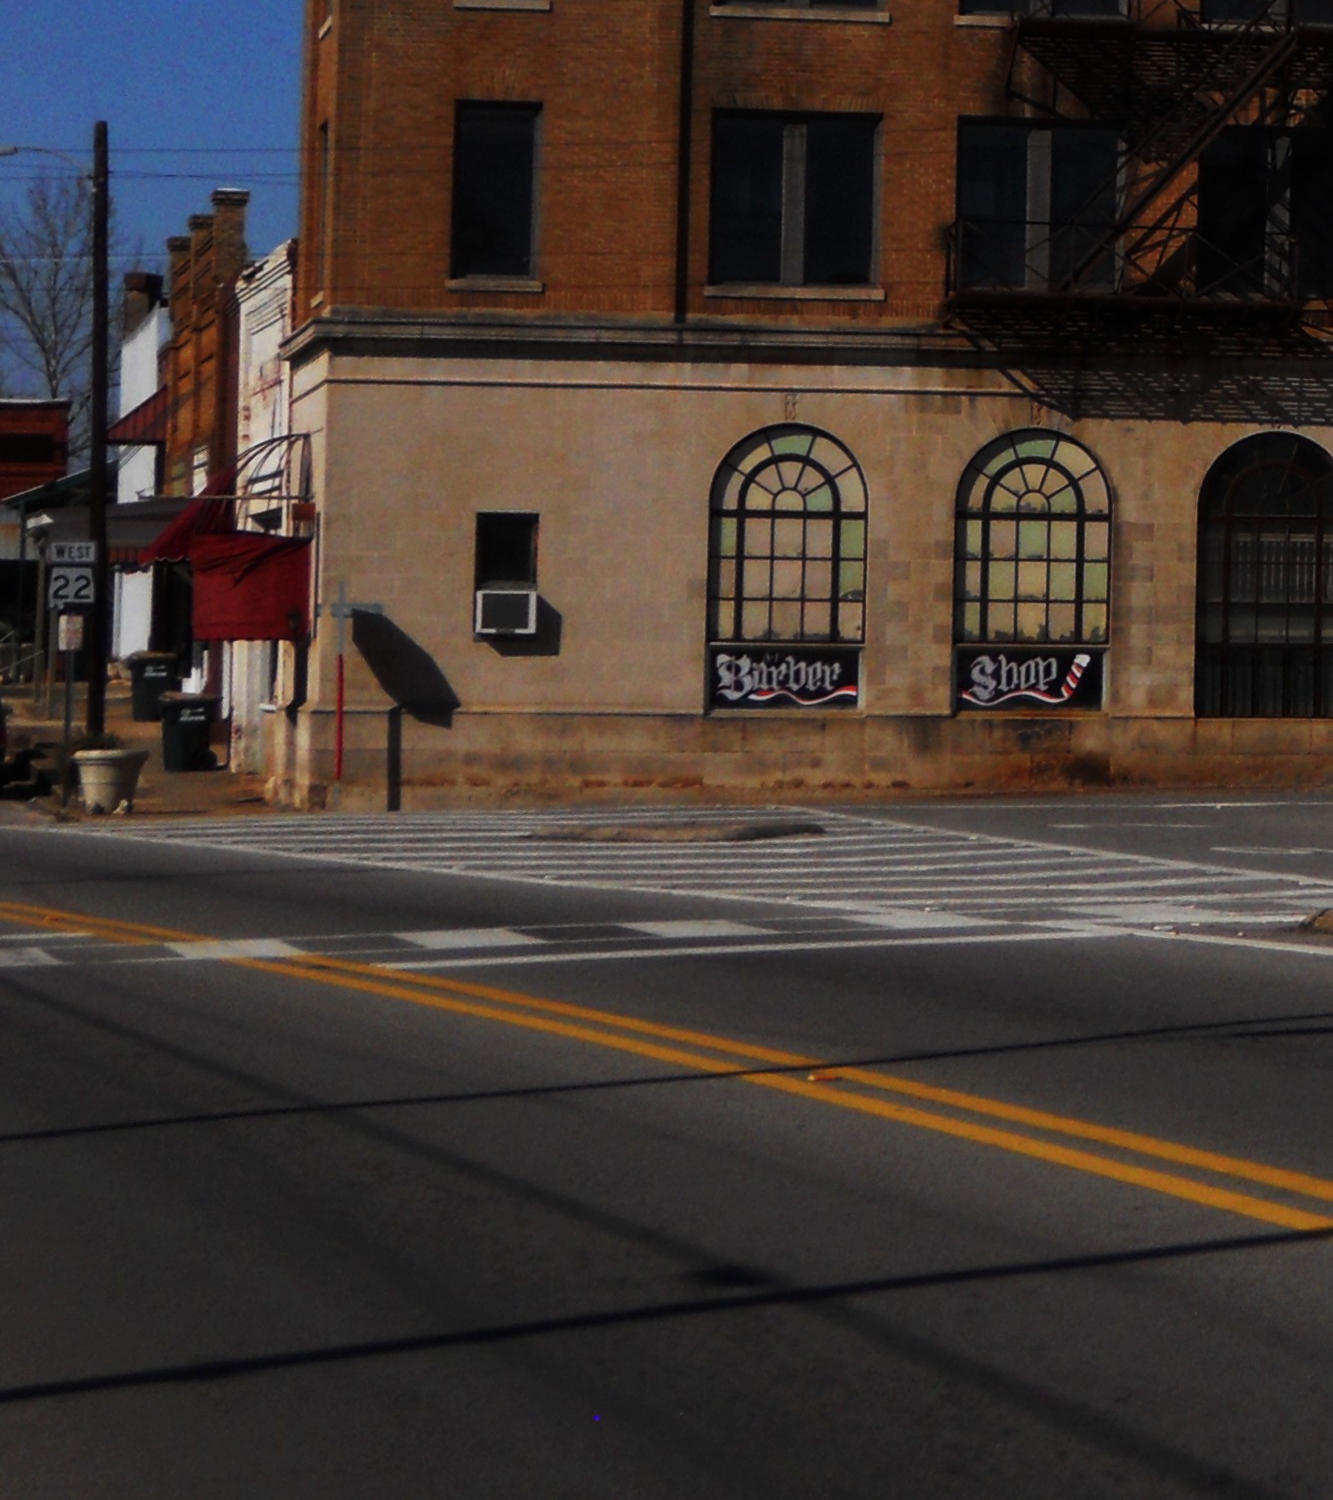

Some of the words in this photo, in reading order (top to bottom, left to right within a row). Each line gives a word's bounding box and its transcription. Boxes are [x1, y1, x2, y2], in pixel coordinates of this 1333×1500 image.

[55, 545, 92, 560] WEST
[52, 575, 91, 600] 22
[716, 653, 843, 701] Barber
[967, 654, 1058, 700] Shop
